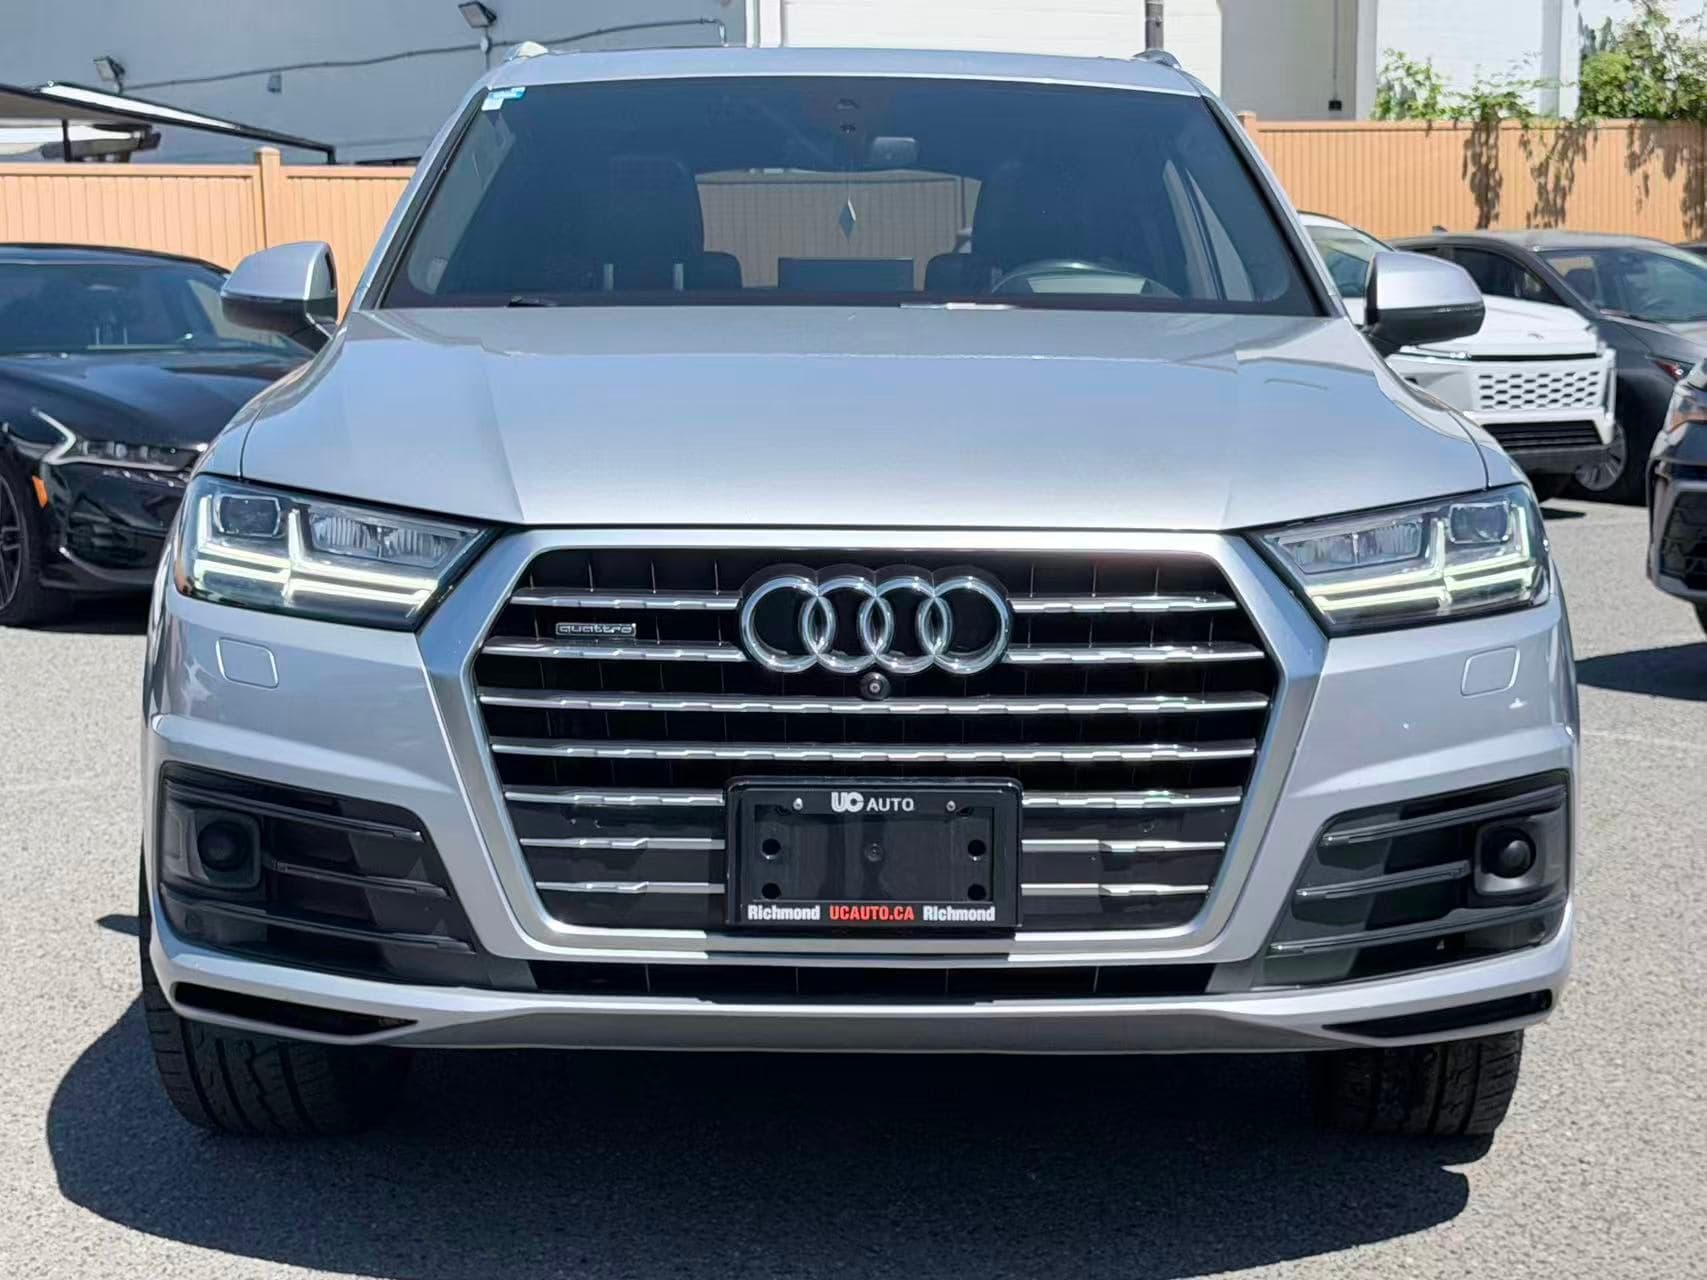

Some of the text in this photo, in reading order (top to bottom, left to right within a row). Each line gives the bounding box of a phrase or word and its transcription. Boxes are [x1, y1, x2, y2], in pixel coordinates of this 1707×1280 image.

[558, 623, 633, 634] quattro
[831, 792, 914, 812] UC AUTO
[747, 904, 996, 921] Richmond UCAUTO.CA Richmond
